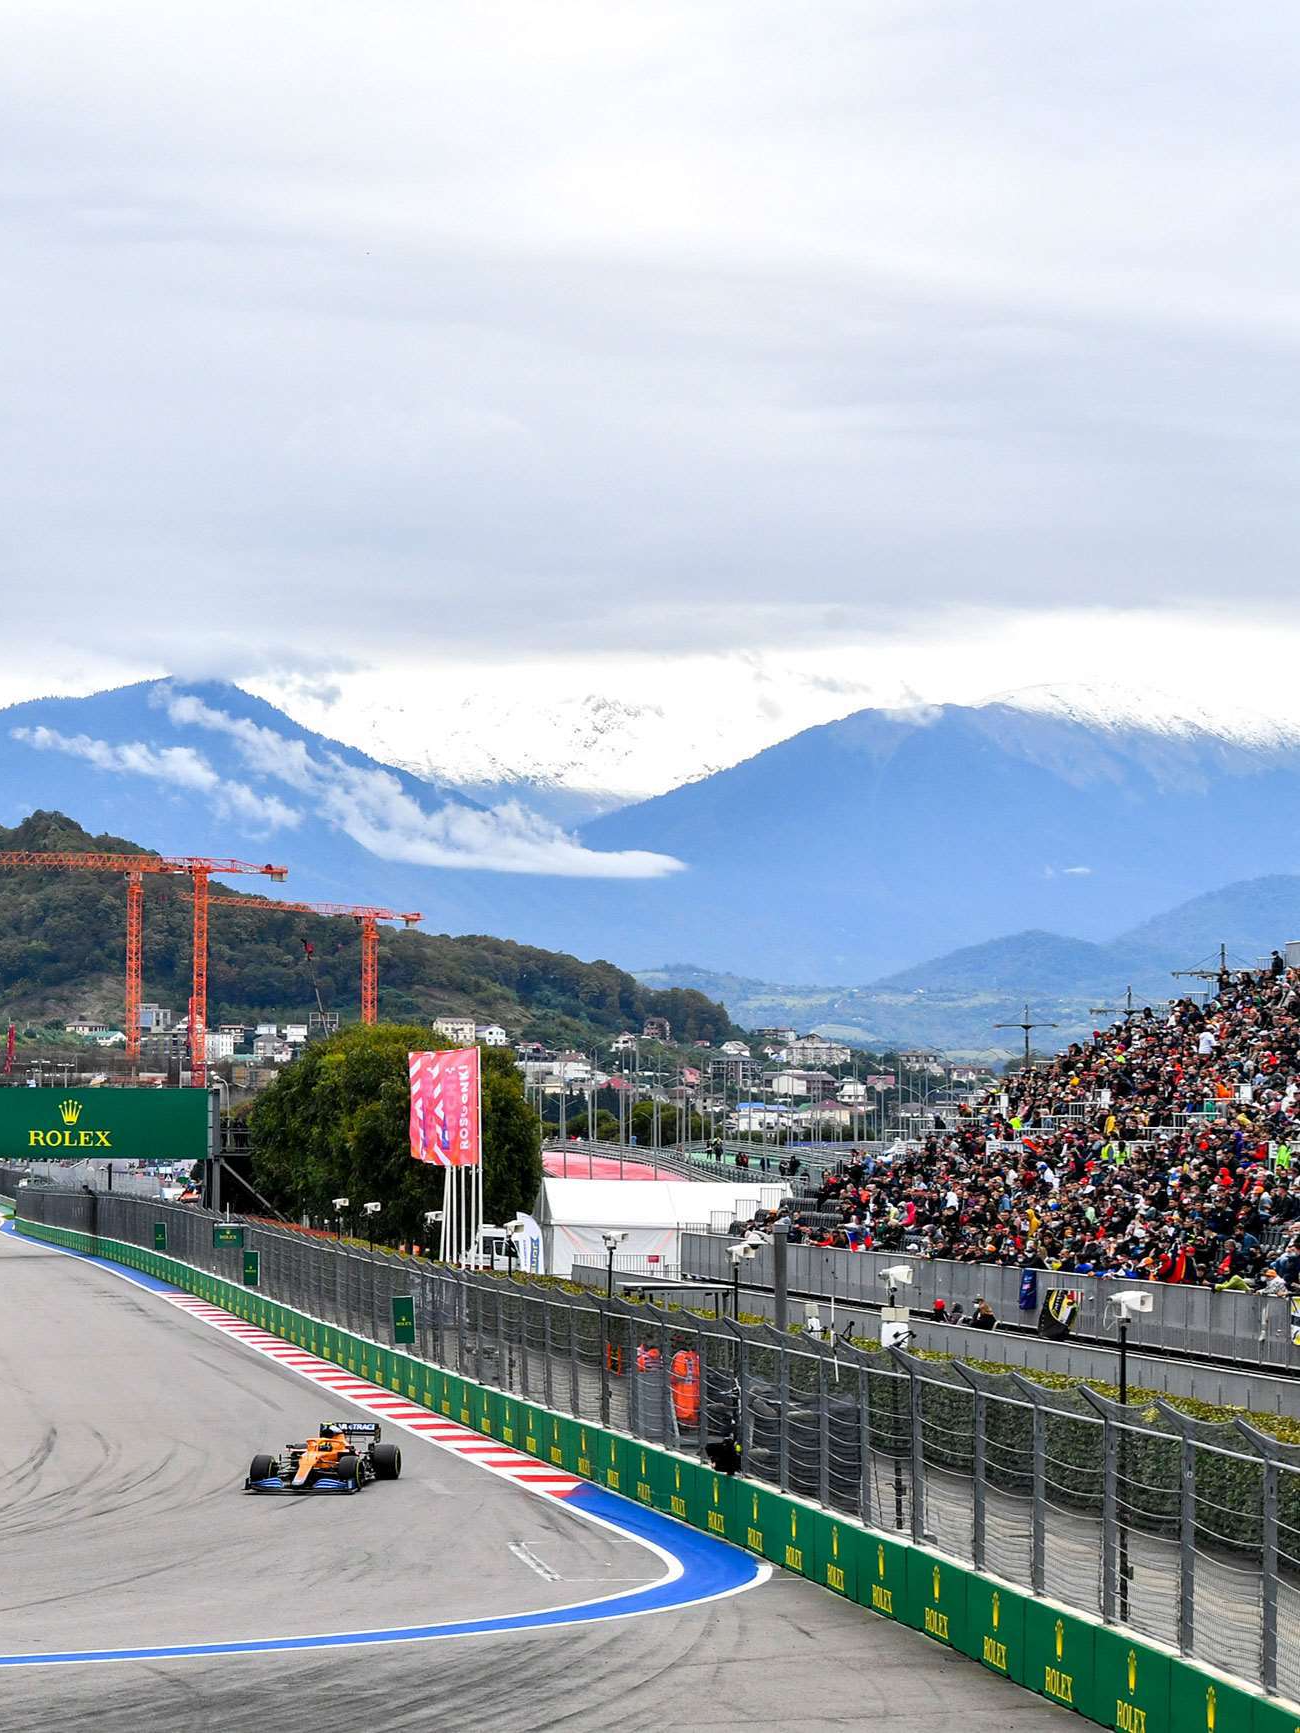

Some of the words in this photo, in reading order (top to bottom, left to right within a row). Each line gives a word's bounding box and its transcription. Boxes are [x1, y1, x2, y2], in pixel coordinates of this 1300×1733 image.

[459, 1065, 471, 1150] ROSGONKI
[29, 1130, 112, 1147] ROLEX
[785, 1544, 802, 1570] ROLEX
[827, 1563, 845, 1591] ROLEX
[872, 1583, 893, 1613] ROLEX
[924, 1607, 948, 1639] ROLEX
[983, 1635, 1007, 1670] ROLEX
[1045, 1666, 1073, 1702] ROLEX
[1116, 1699, 1147, 1733] ROLEX
